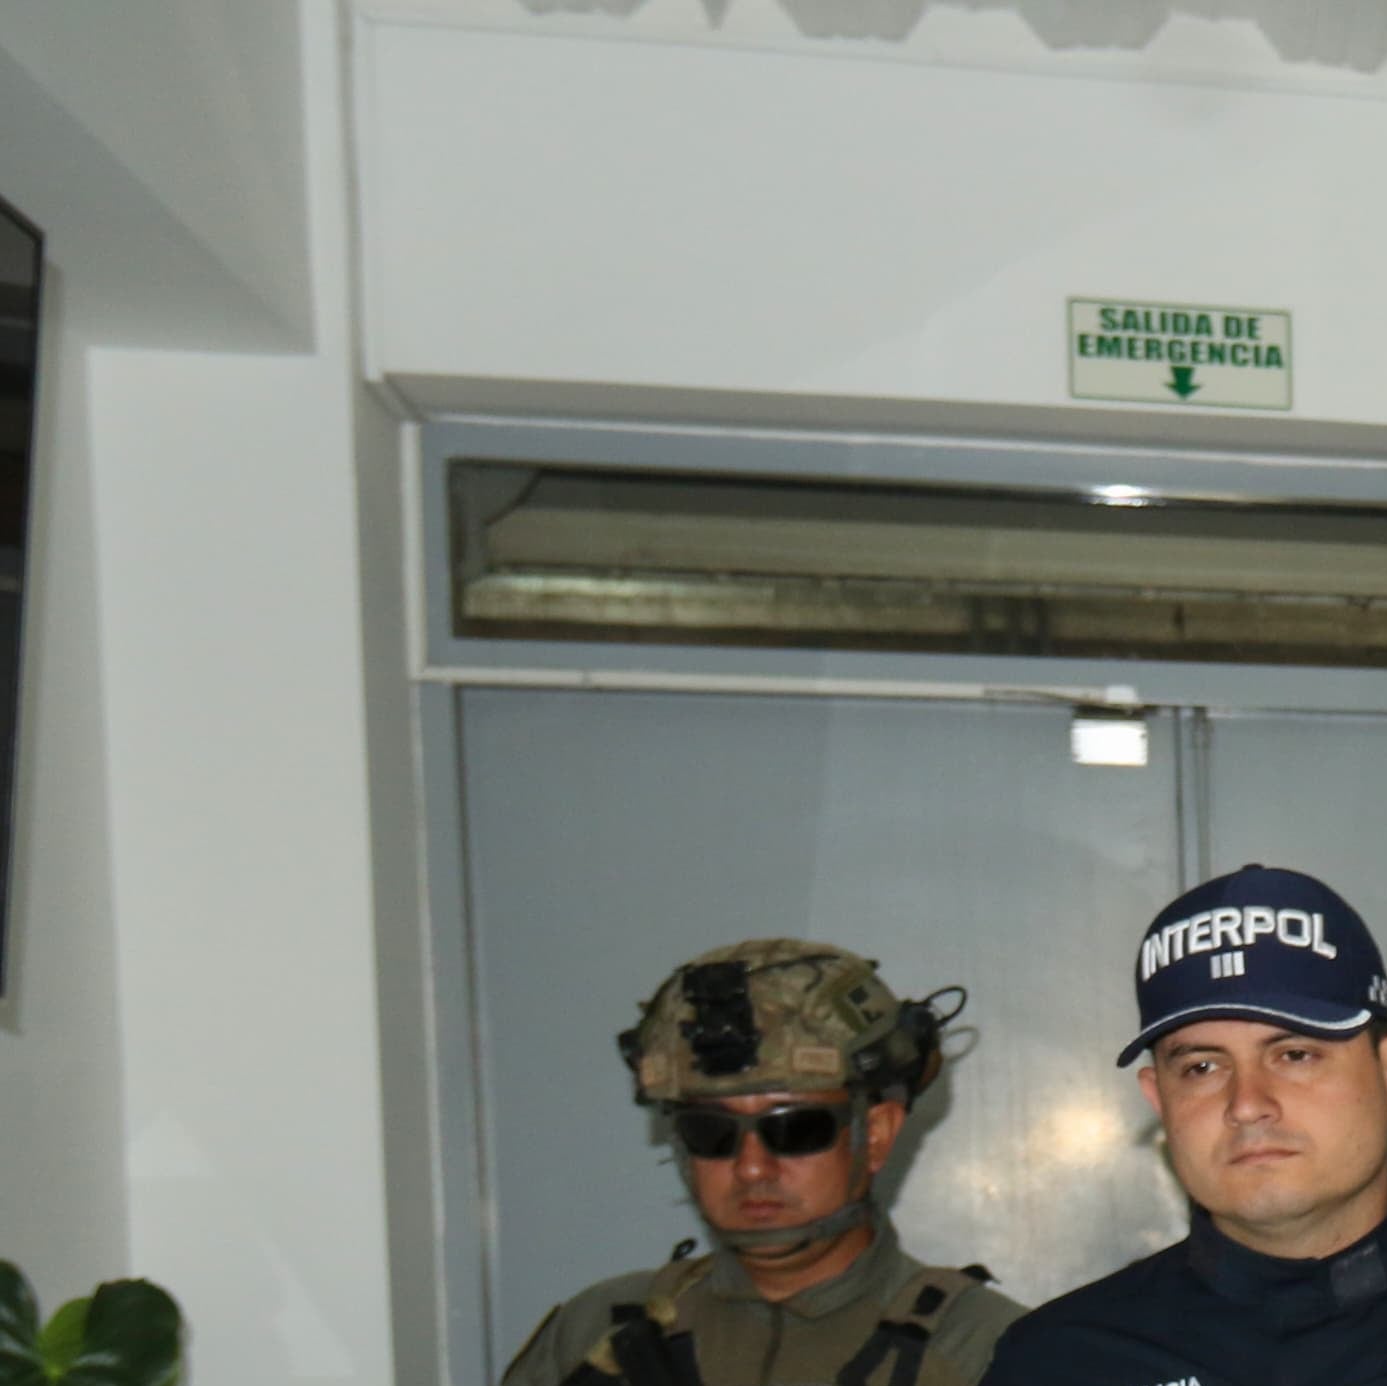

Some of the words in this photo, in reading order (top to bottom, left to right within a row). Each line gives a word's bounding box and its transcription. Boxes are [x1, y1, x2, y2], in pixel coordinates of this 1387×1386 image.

[1100, 307, 1213, 336] SALIDA
[1223, 315, 1260, 341] DE
[1077, 333, 1284, 369] EMERGENCIA
[1140, 904, 1338, 982] INTERPOL
